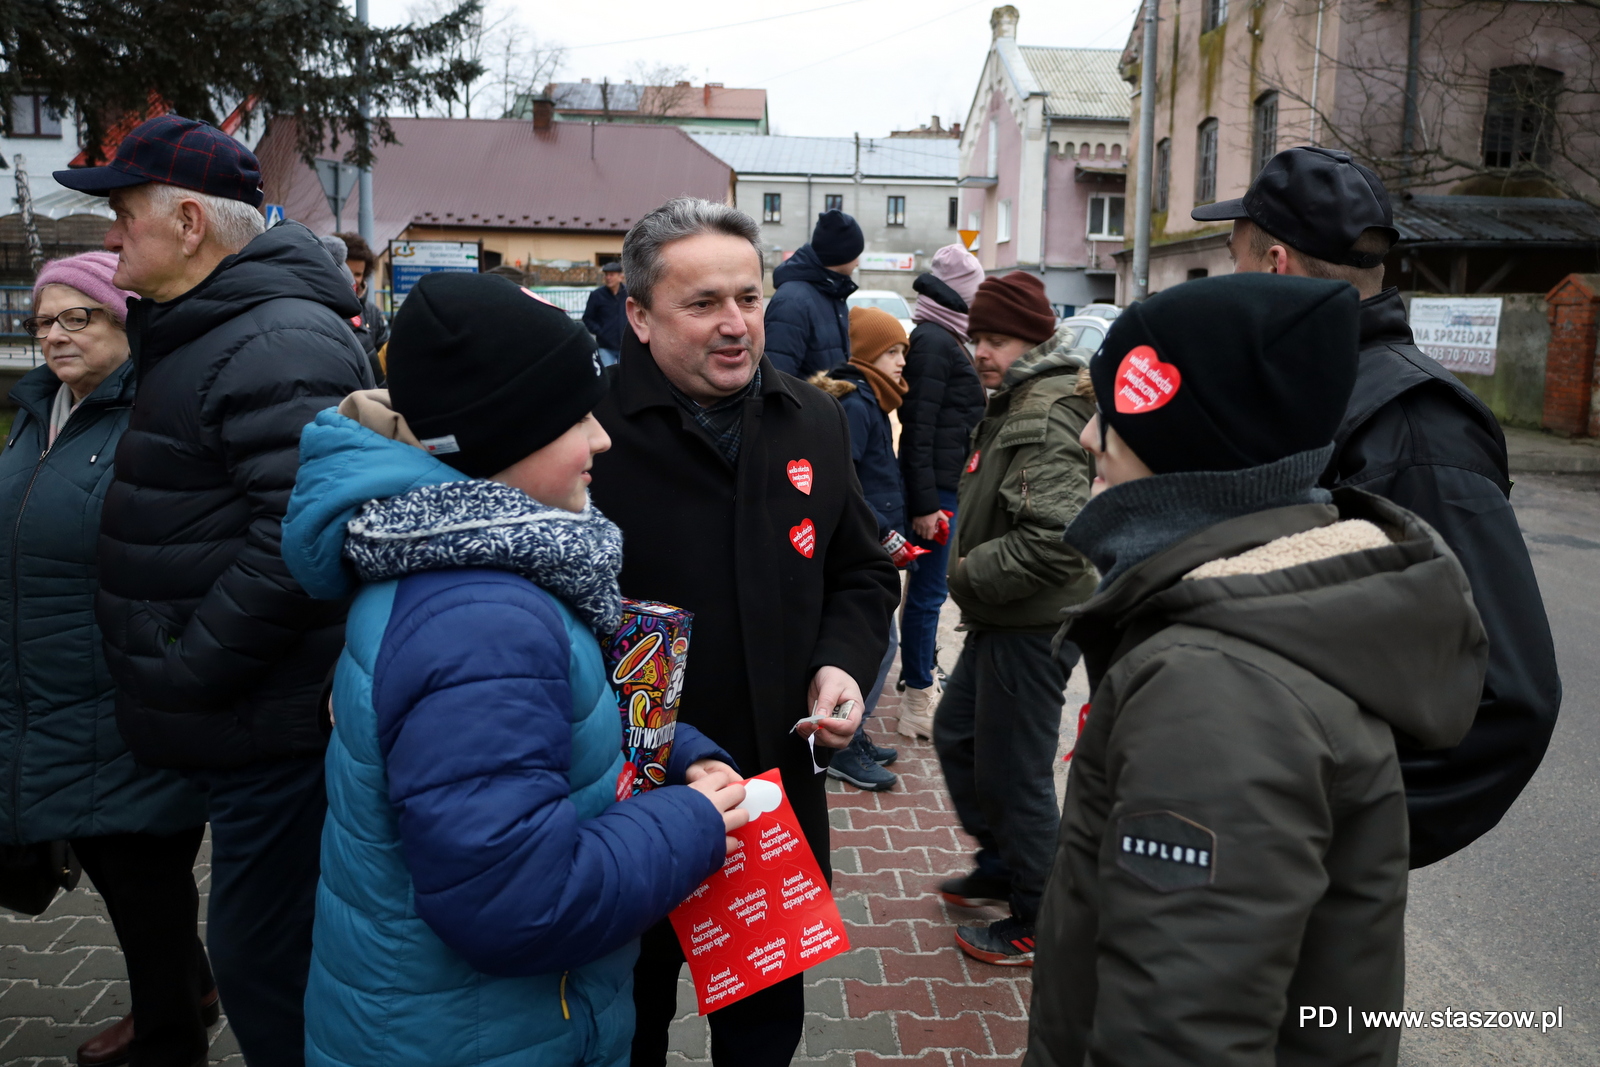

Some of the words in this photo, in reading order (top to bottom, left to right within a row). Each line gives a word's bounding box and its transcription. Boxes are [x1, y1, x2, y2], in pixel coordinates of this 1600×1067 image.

[1414, 328, 1430, 341] NA
[1434, 329, 1492, 345] SPRZEDAŻ
[1428, 346, 1444, 360] 503
[1448, 348, 1460, 362] 70
[1463, 349, 1474, 363] 70
[1478, 350, 1491, 364] 73
[1129, 355, 1150, 374] wielka
[1146, 369, 1173, 394] orkiestra
[1118, 385, 1146, 410] pomocy
[628, 726, 642, 748] TU
[762, 823, 782, 839] pomocy
[782, 838, 799, 852] wielka
[1122, 836, 1209, 867] EXPLORE
[760, 846, 782, 861] orkiestra
[724, 862, 744, 878] pomocy
[783, 870, 804, 887] pomocy
[728, 897, 745, 912] wielka
[744, 888, 766, 902] orkiestra
[805, 886, 822, 900] wielka
[736, 897, 768, 919] świątecznej
[782, 895, 805, 910] orkiestra
[693, 917, 713, 933] pomocy
[745, 911, 766, 927] pomocy
[803, 920, 824, 936] pomocy
[713, 932, 731, 947] wielka
[822, 935, 840, 949] wielka
[692, 941, 714, 956] orkiestra
[746, 946, 764, 961] wielka
[763, 937, 786, 952] orkiestra
[800, 943, 822, 958] orkiestra
[754, 947, 786, 969] świątecznej
[710, 967, 731, 983] pomocy
[761, 960, 782, 976] pomocy
[727, 982, 745, 995] wielka
[705, 990, 728, 1004] orkiestra
